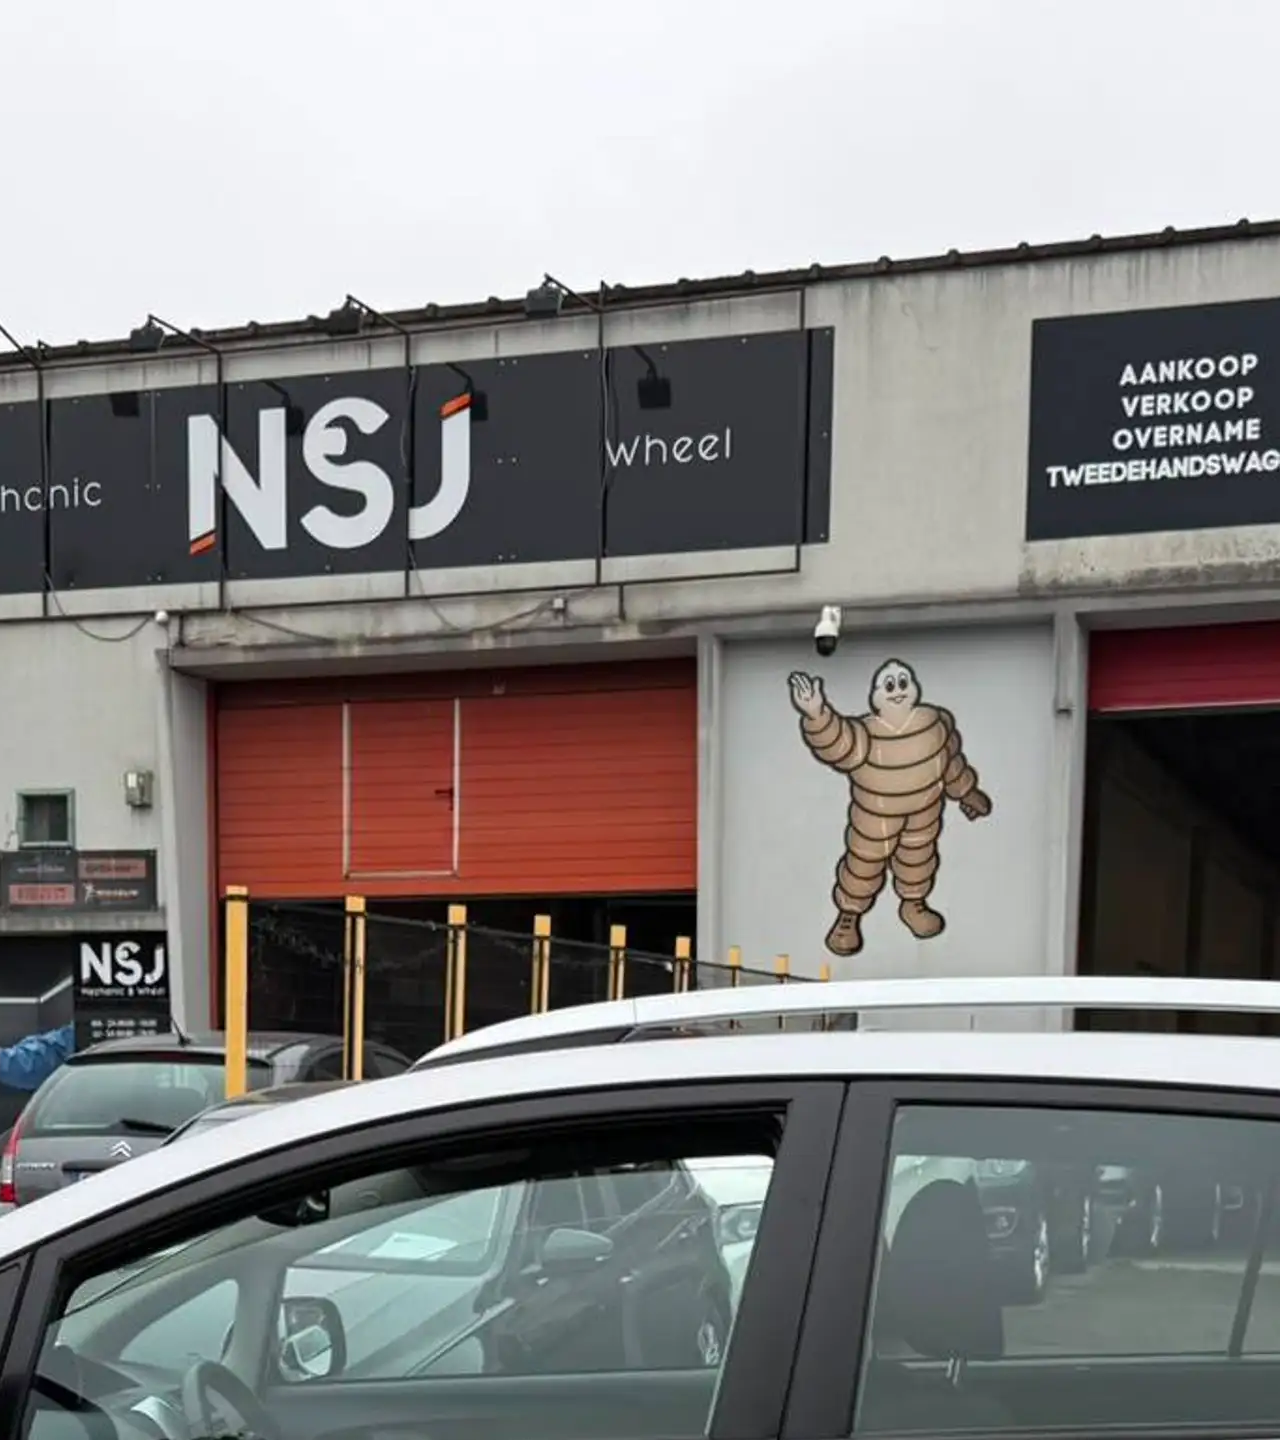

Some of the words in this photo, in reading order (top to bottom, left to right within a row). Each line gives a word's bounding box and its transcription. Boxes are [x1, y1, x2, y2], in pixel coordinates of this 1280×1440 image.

[1119, 353, 1259, 387] AANKOOP
[1121, 386, 1254, 418] VERKOOP
[1112, 417, 1261, 450] OVERNAME
[186, 393, 473, 556] NSJ
[606, 427, 733, 467] Wheel
[80, 941, 165, 987] NSJ
